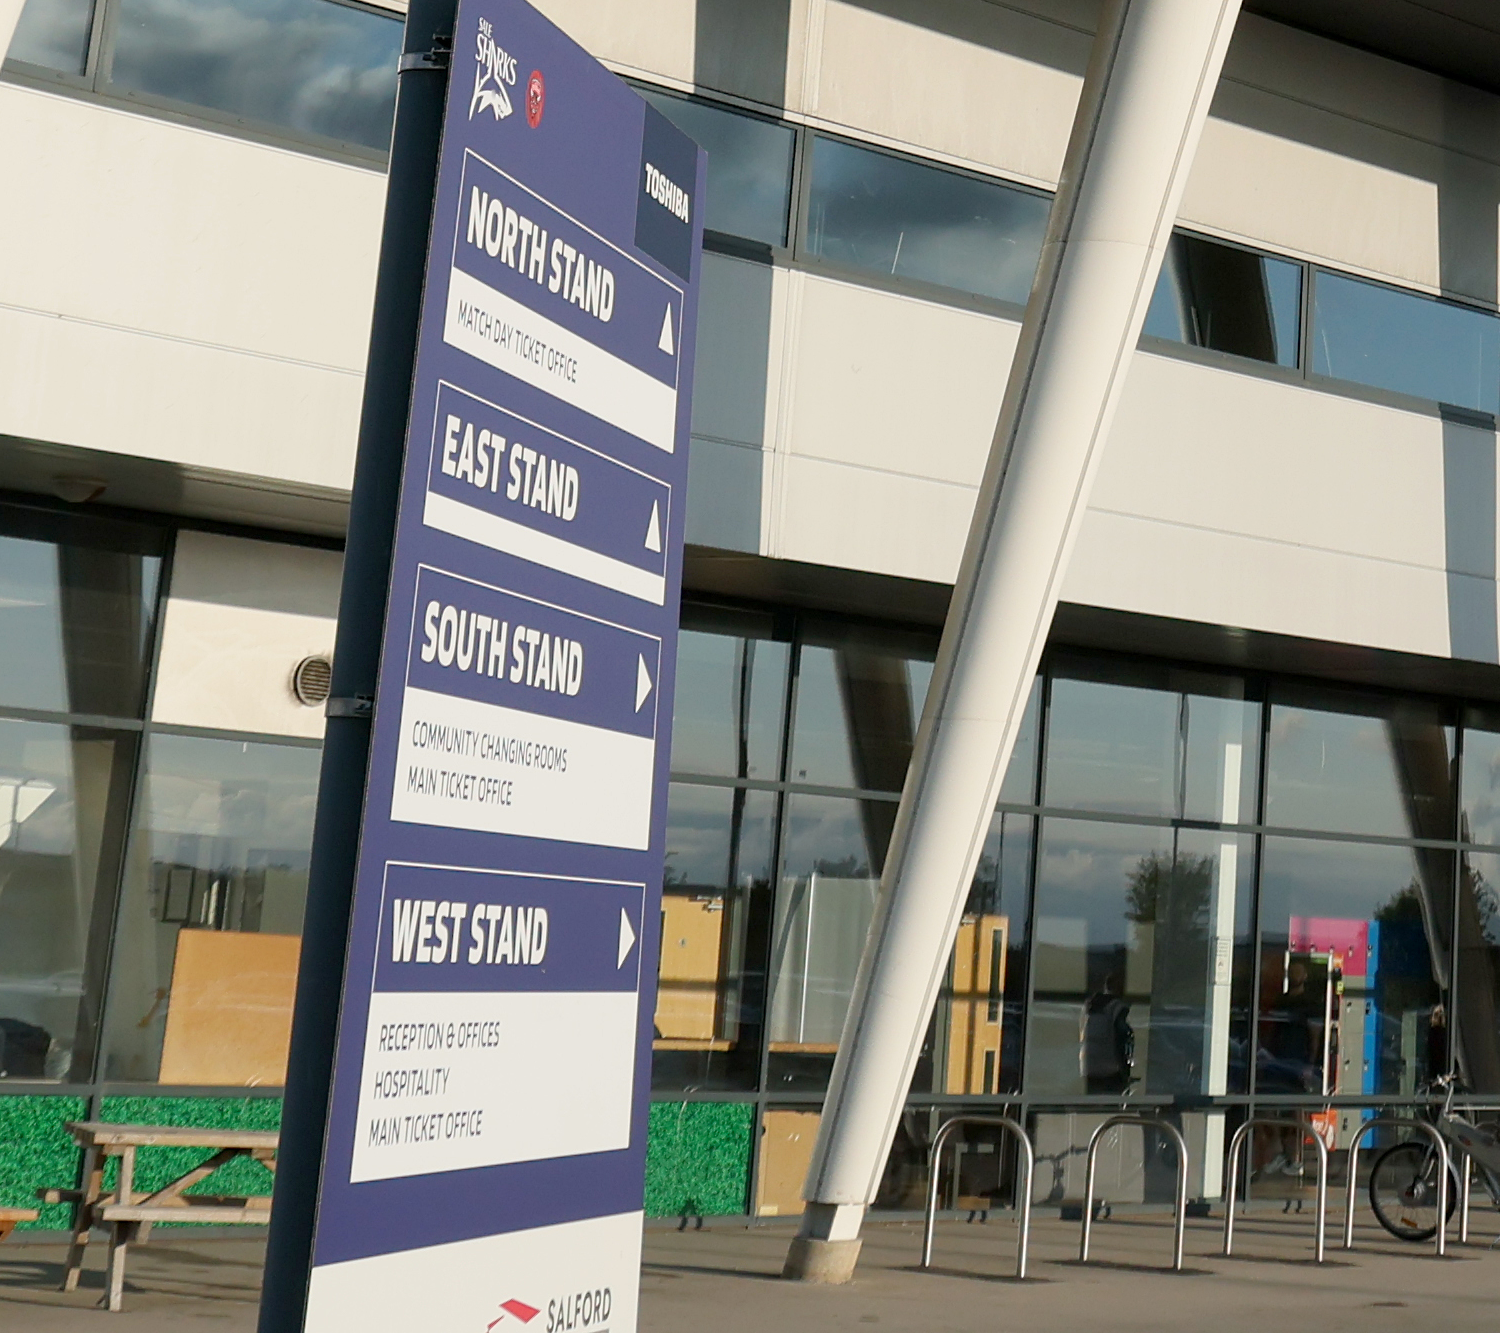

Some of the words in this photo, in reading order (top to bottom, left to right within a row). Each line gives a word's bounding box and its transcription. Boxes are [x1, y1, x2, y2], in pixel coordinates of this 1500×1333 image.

[478, 16, 493, 38] SALE
[475, 33, 517, 86] SHARKS
[645, 162, 689, 224] TOSHIBA
[467, 185, 546, 285] NORTH
[548, 237, 615, 323] STAND
[457, 299, 492, 340] MATCH
[493, 318, 513, 350] DAY
[515, 329, 546, 367] TICKET
[547, 347, 577, 383] OFFICE
[441, 413, 506, 493] EAST
[506, 443, 579, 522] STAND
[420, 600, 508, 679] SOUTH
[509, 625, 583, 697] STAND
[412, 720, 480, 757] COMMUNITY
[480, 733, 532, 767] CHANGING
[533, 743, 568, 772] ROOMS
[407, 765, 438, 796] MAIN
[440, 770, 477, 801] TICKET
[477, 776, 513, 806] OFFICE
[391, 898, 466, 964] WEST
[467, 903, 549, 966] STAND
[378, 1022, 445, 1052] RECEPTION
[446, 1022, 455, 1050] &
[457, 1021, 500, 1049] OFFICES
[373, 1067, 450, 1100] HOSPITALITY
[368, 1116, 402, 1148] MAIN
[404, 1112, 444, 1144] TICKET
[445, 1109, 484, 1140] OFFICE
[546, 1287, 612, 1333] SALFORD
